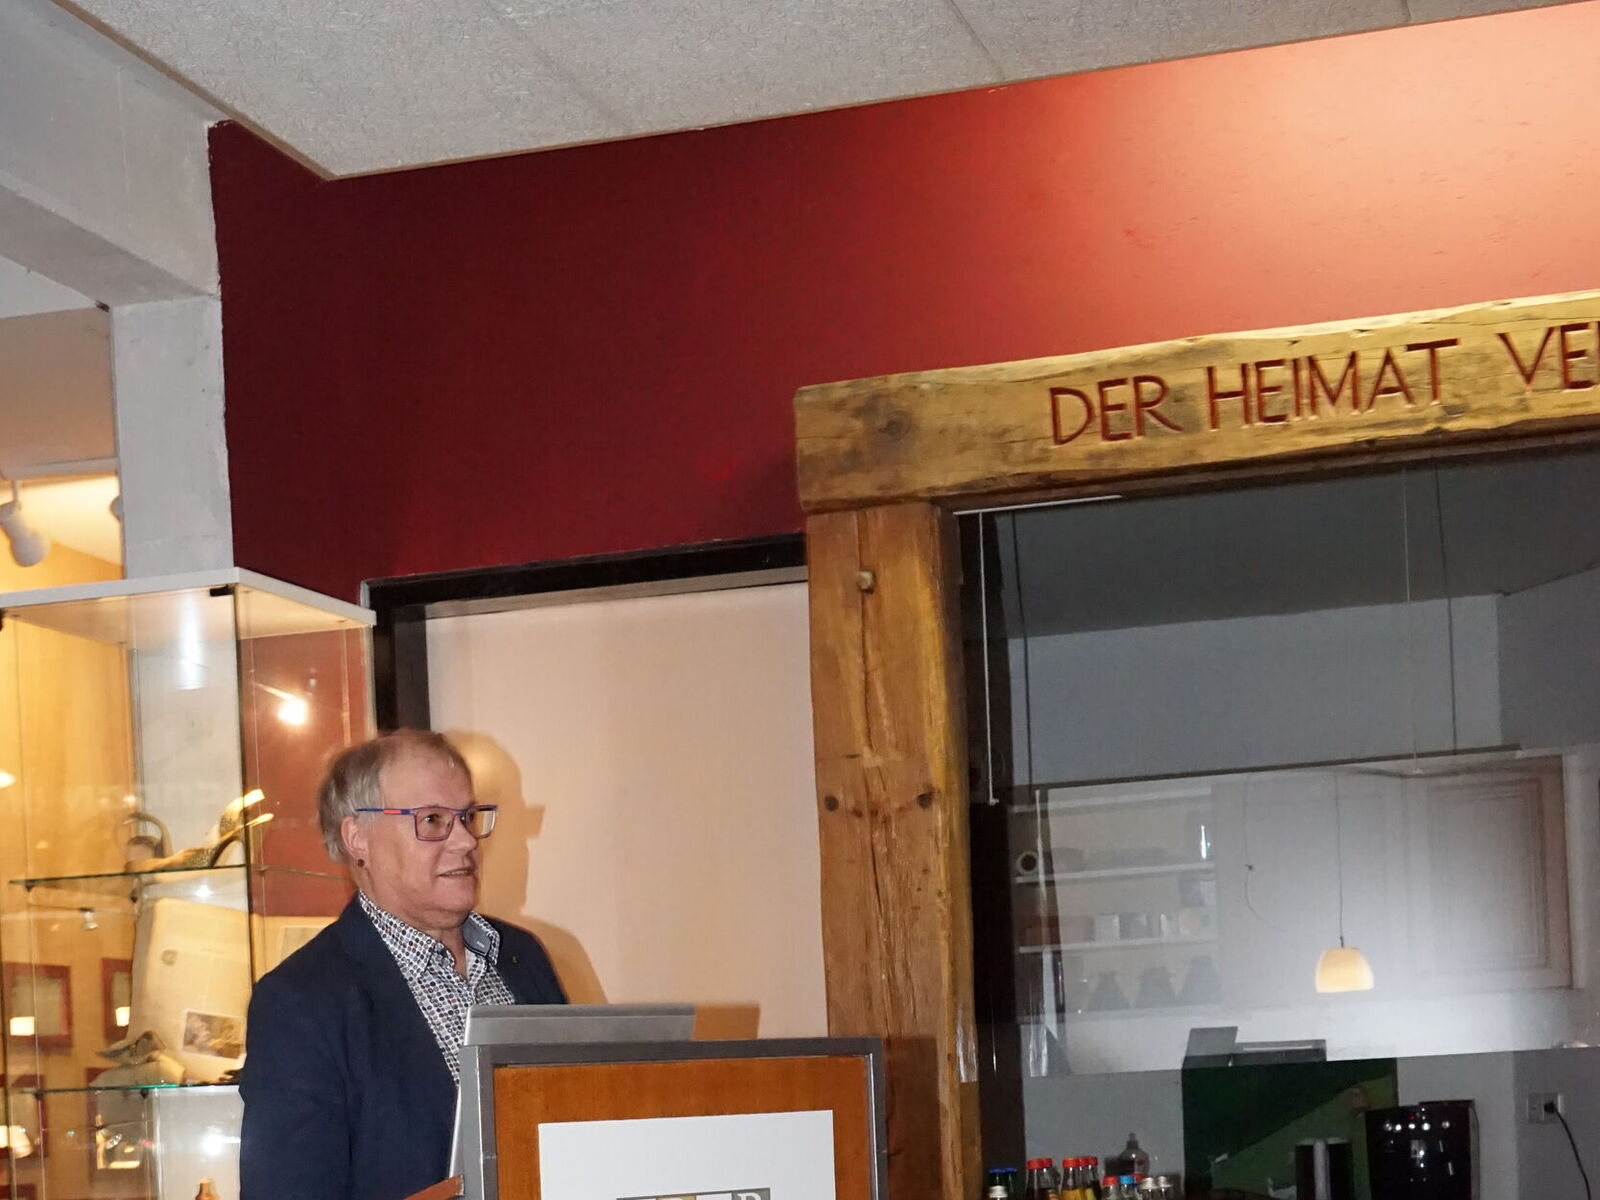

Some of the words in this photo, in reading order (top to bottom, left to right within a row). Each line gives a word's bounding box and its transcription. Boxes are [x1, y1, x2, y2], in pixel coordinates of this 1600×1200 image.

[1049, 374, 1183, 446] DER
[1206, 338, 1458, 431] HEIMAT
[1496, 320, 1600, 390] VE
